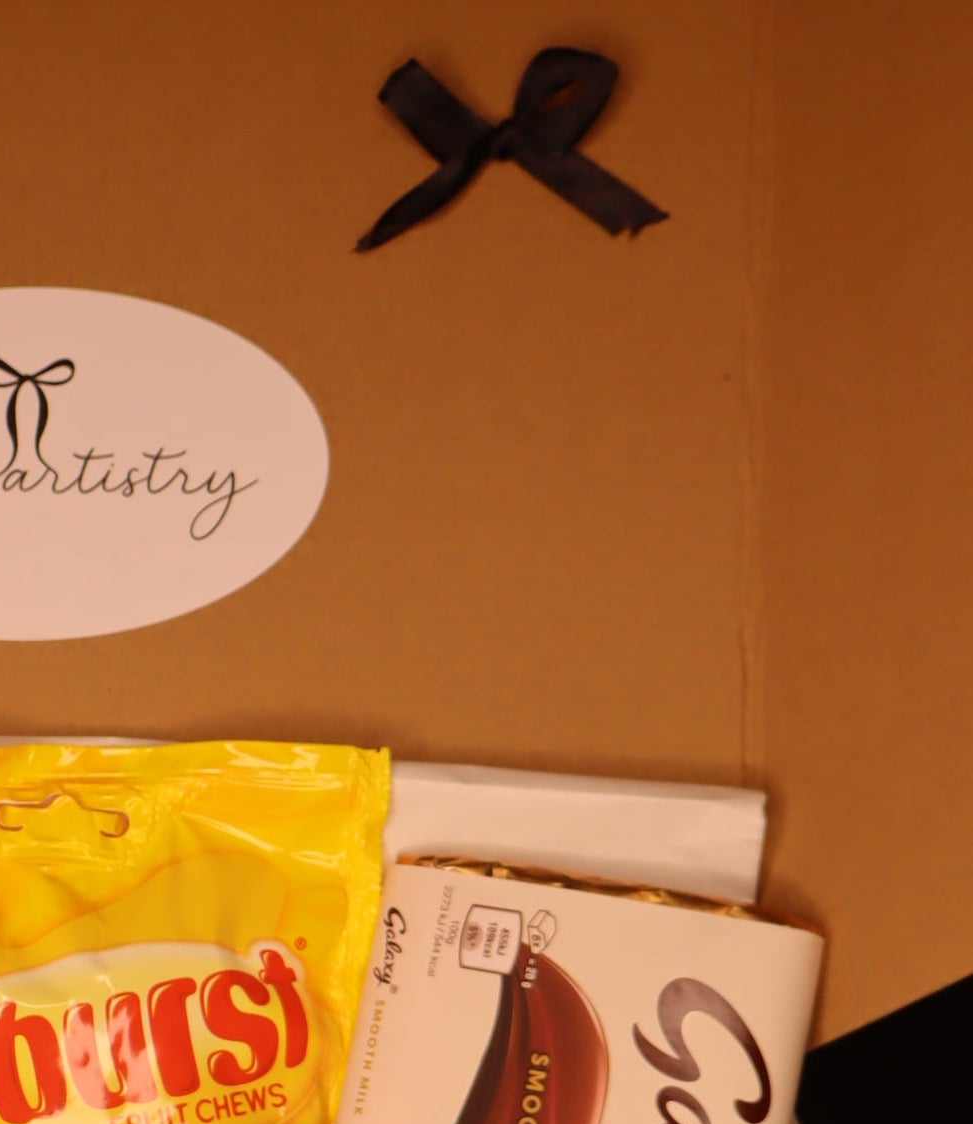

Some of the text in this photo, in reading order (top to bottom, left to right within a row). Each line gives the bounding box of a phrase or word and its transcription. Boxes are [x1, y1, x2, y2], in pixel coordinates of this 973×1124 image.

[440, 885, 453, 911] 2273
[373, 906, 406, 985] Galaxy
[354, 1000, 384, 1115] SMOOTH MILK
[195, 1083, 287, 1123] CHEWS
